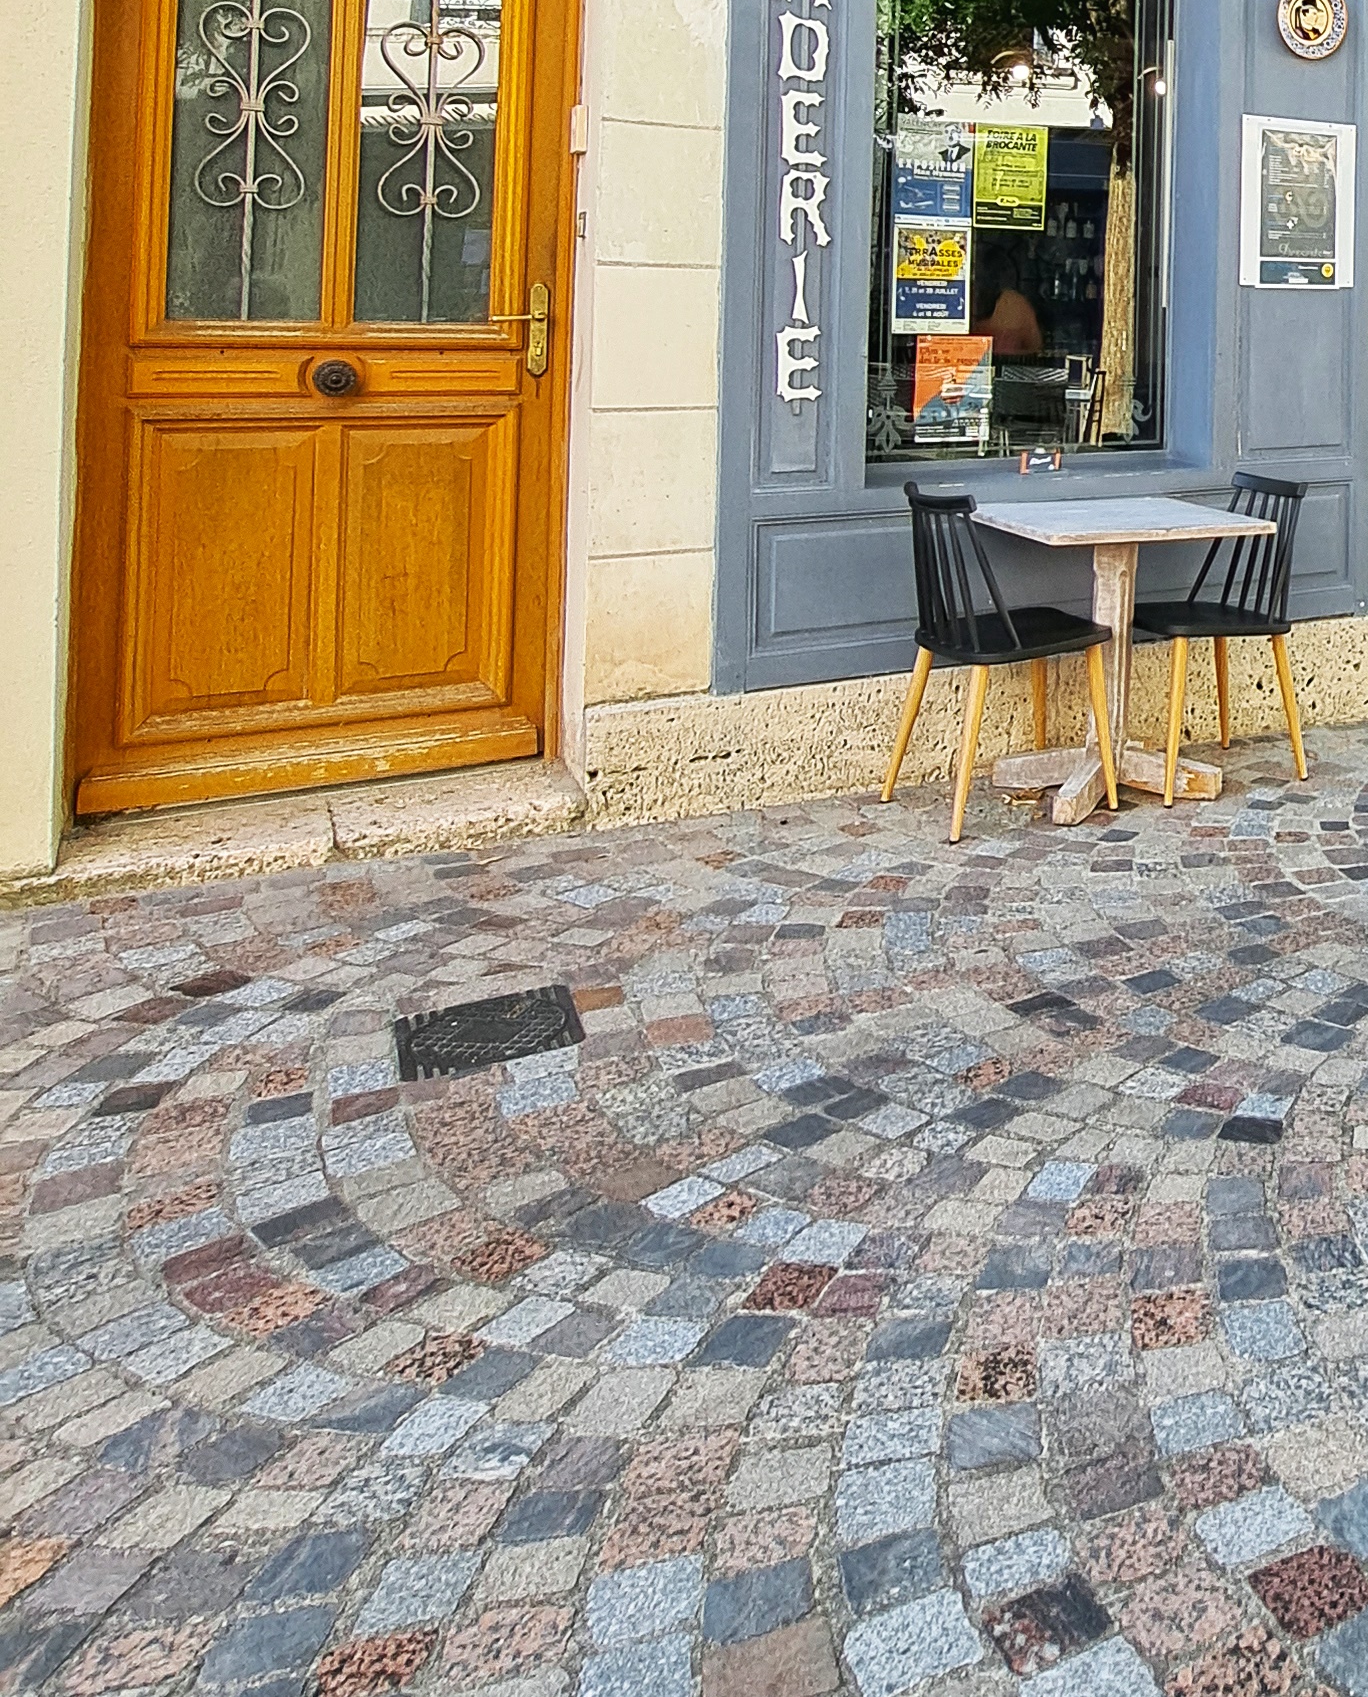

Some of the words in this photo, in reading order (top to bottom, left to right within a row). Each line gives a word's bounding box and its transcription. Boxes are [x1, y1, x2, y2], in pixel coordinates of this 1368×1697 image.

[987, 130, 1016, 141] FOIRE
[1026, 133, 1037, 143] LA
[986, 141, 1038, 152] BROCANTE
[898, 158, 966, 172] EXPOSITION
